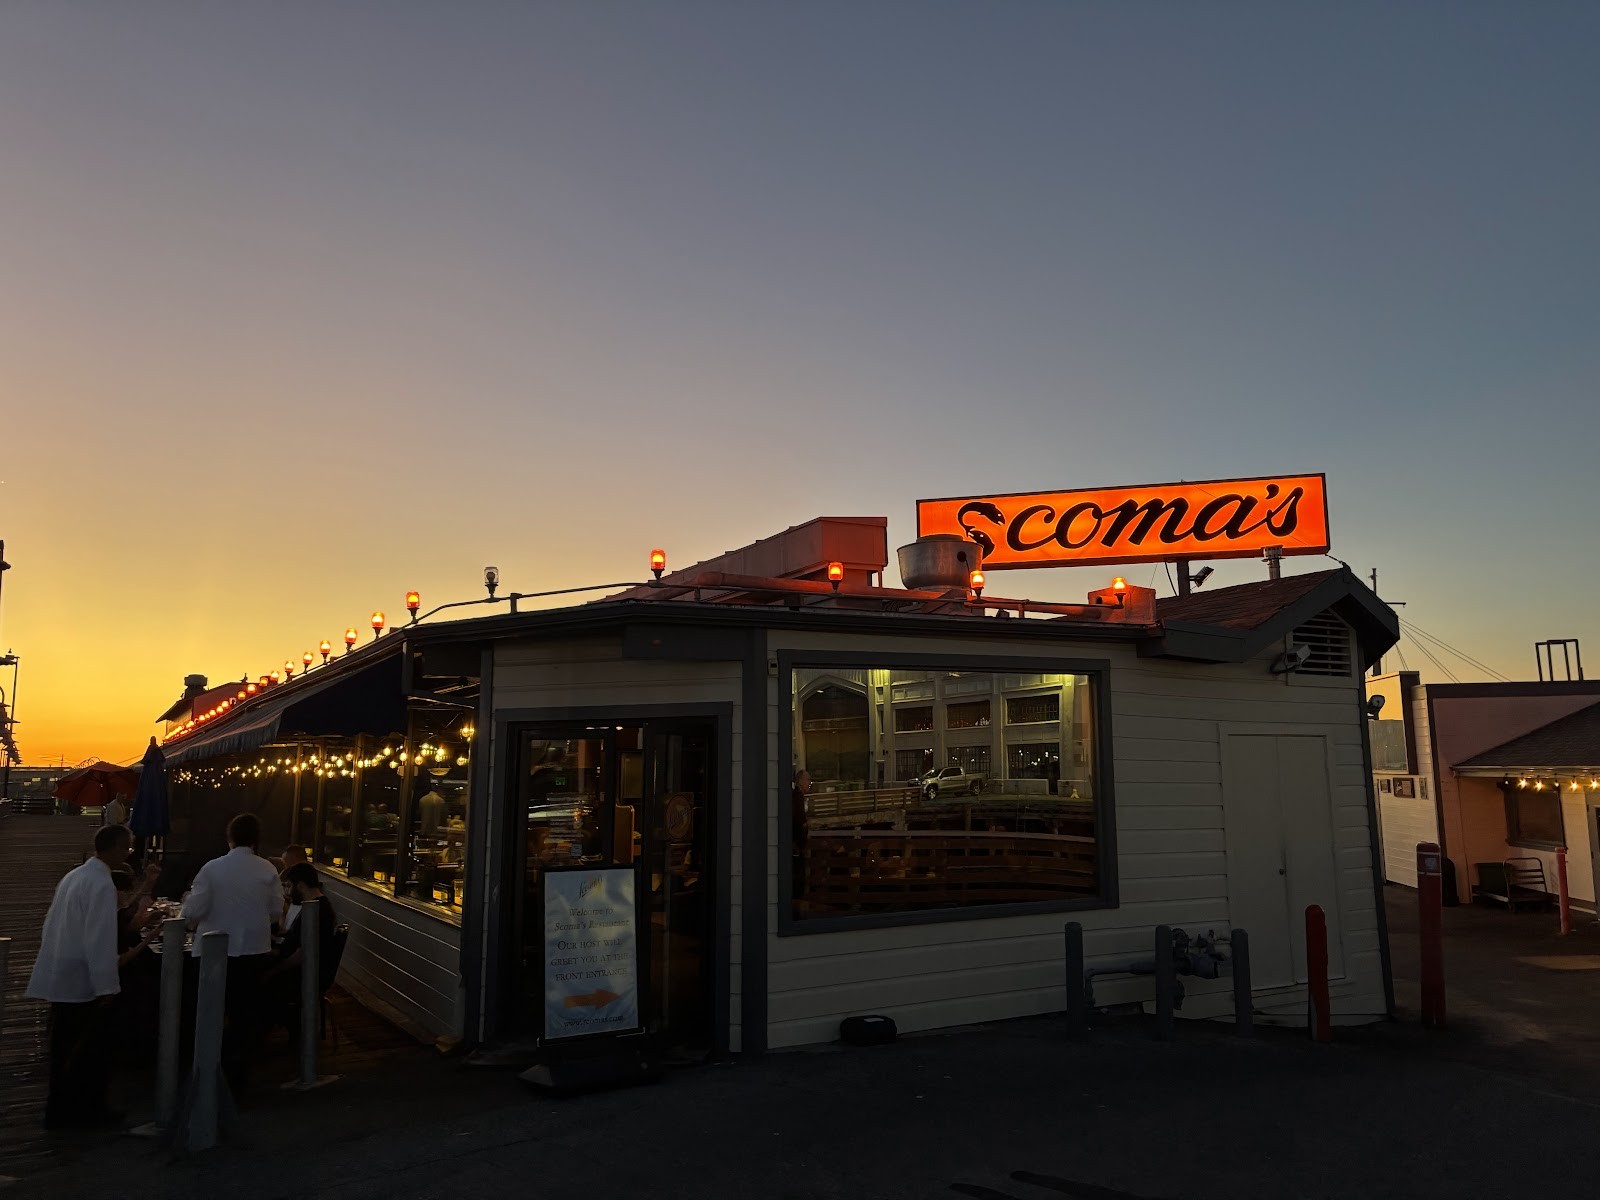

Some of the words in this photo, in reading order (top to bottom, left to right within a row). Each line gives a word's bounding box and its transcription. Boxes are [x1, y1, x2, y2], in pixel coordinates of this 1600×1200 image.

[957, 483, 1304, 558] Scoma's
[569, 908, 603, 917] Welcome
[580, 940, 601, 949] HOST
[603, 939, 622, 947] WILL
[550, 957, 578, 967] GREET
[580, 955, 598, 964] YOU
[601, 954, 611, 962] AT
[614, 952, 629, 961] THE
[555, 971, 584, 981] FRONT
[585, 967, 627, 979] ENTRANCE
